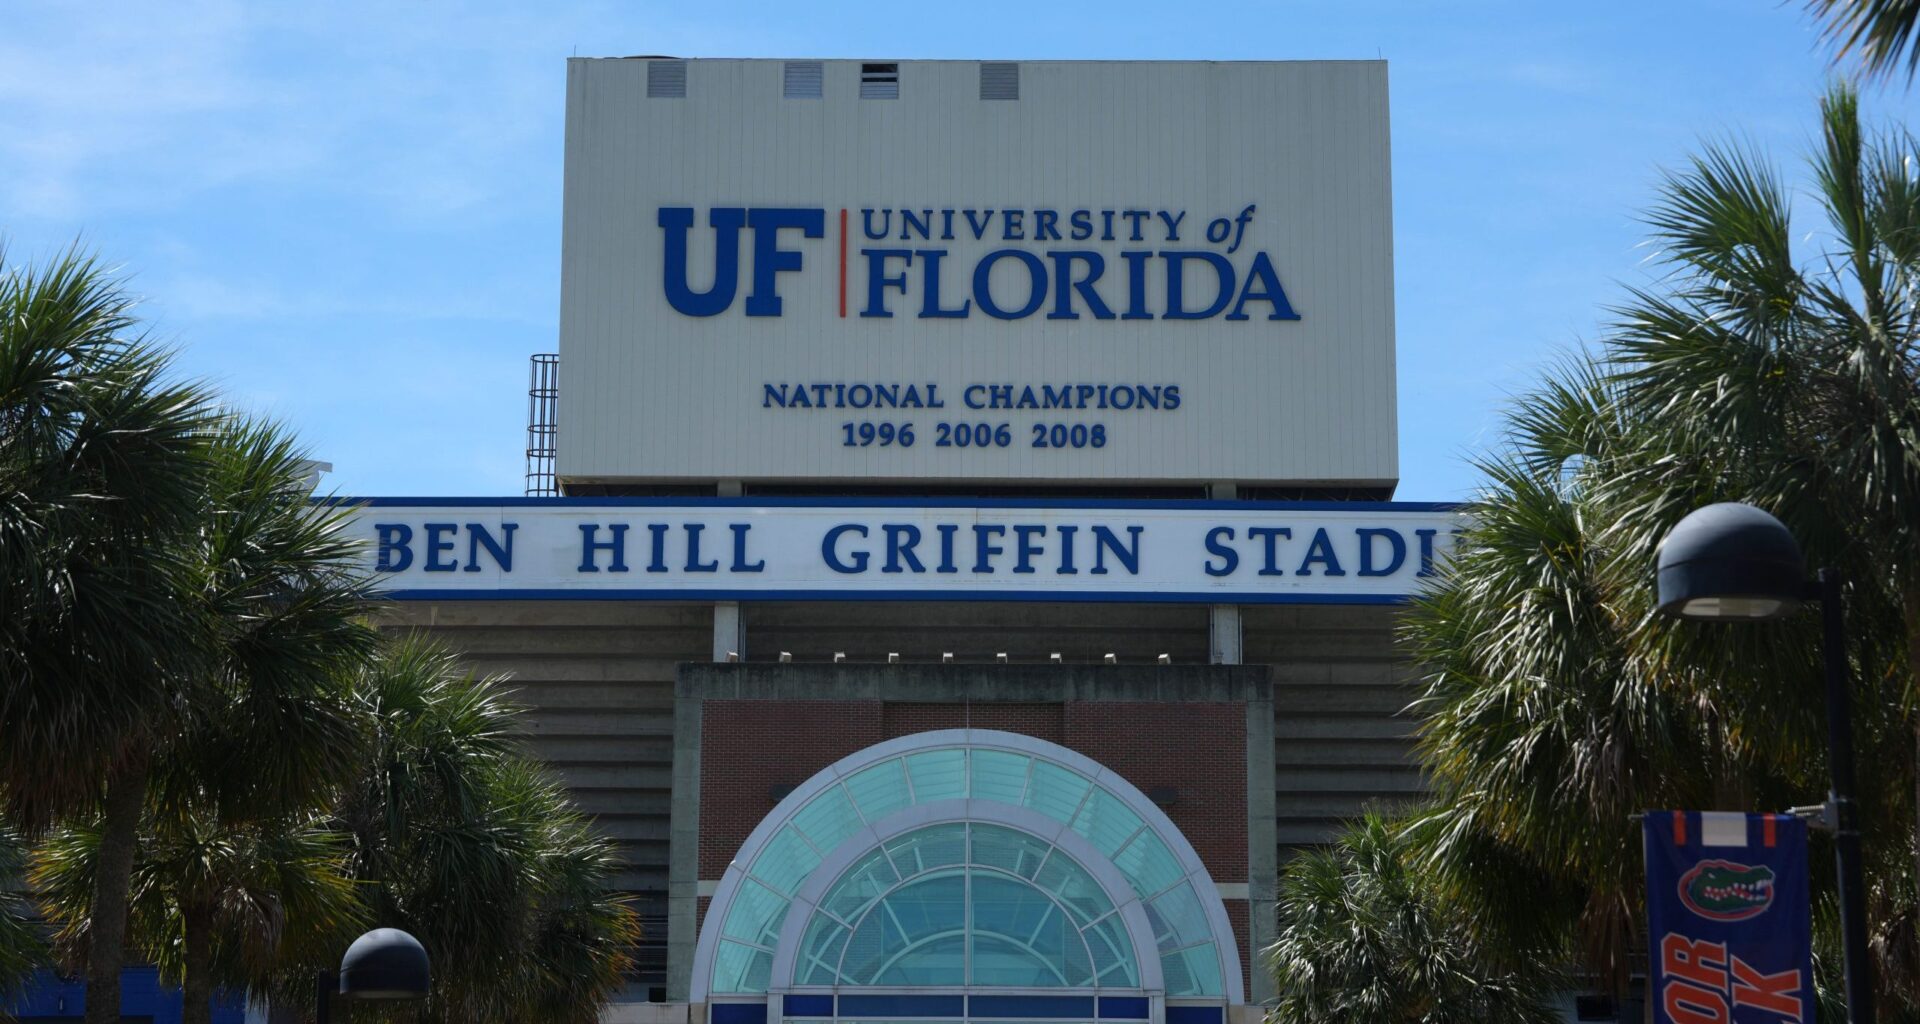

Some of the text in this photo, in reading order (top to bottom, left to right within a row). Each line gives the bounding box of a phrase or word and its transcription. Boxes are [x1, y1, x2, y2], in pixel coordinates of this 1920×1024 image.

[863, 204, 1257, 252] UNIVERSITY of
[657, 204, 826, 317] UF
[860, 249, 1301, 321] FLORIDA
[763, 381, 1182, 410] NATIONAL CHAMPIONS
[843, 421, 1108, 449] 1996 2006 2008
[375, 523, 1470, 577] BEN HILL GRIFFIN STADI
